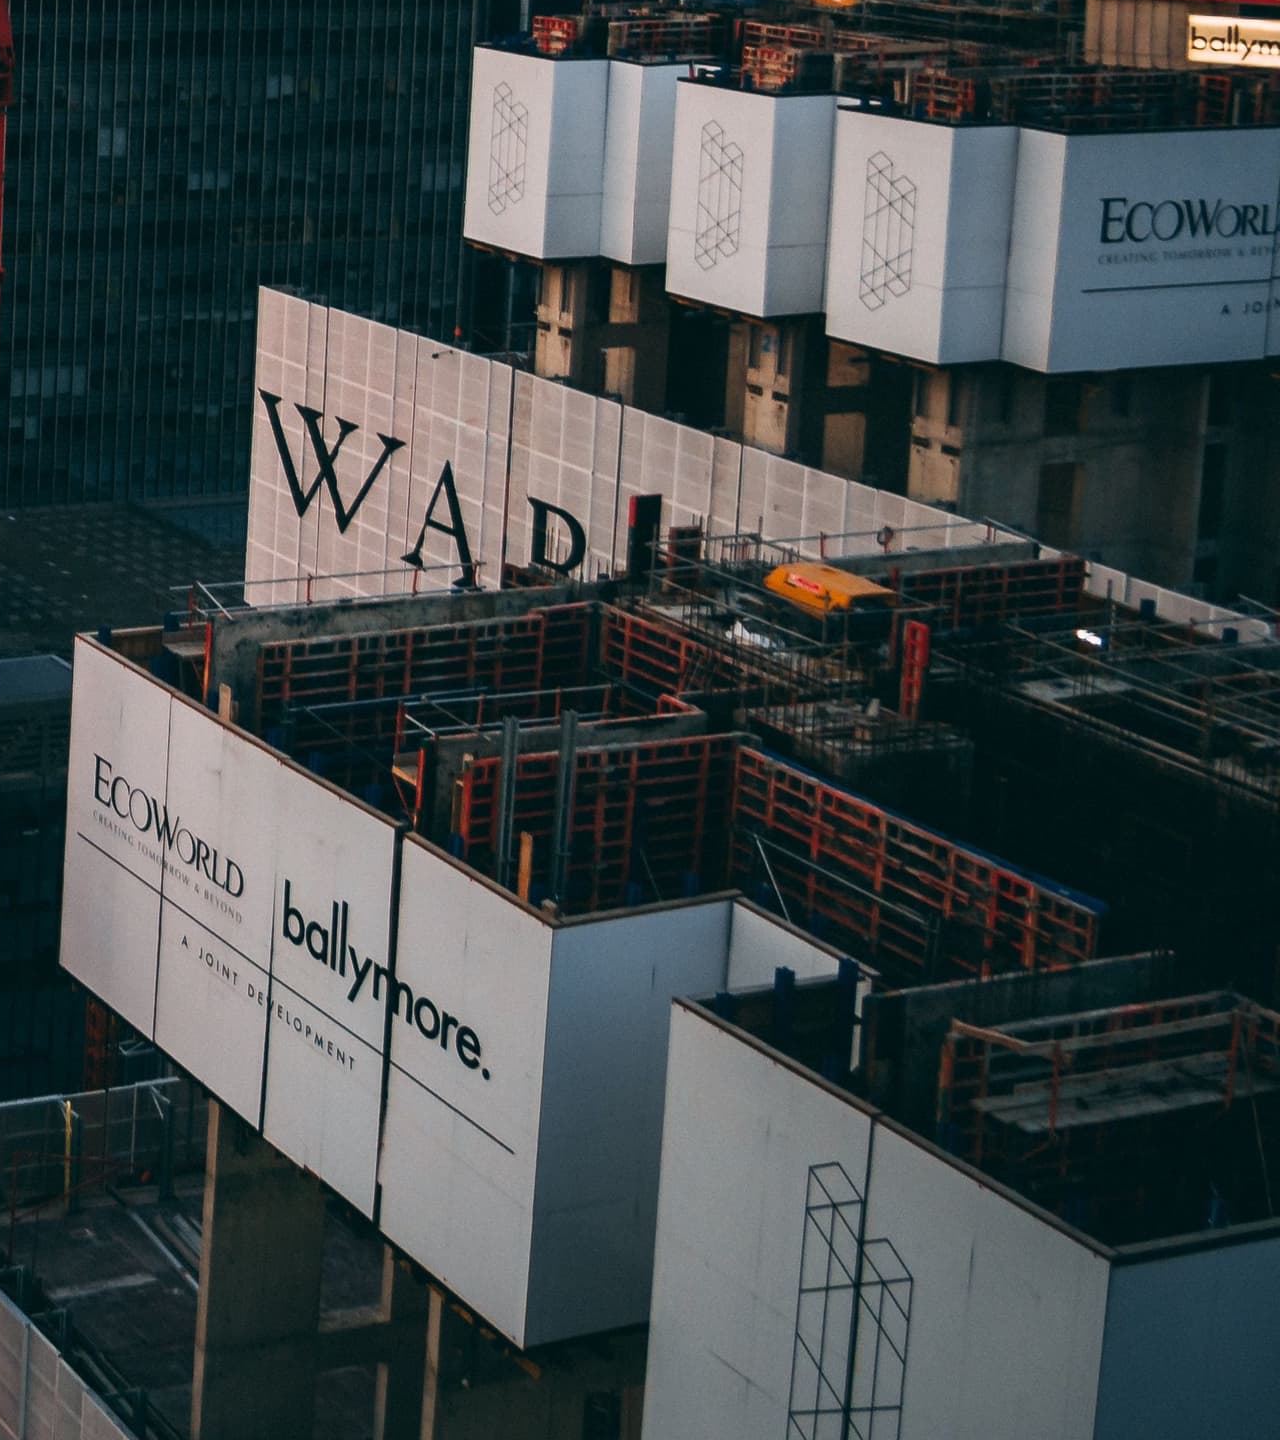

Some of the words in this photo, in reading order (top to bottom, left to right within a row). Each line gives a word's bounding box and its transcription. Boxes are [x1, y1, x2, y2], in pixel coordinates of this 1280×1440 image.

[181, 935, 189, 950] A
[198, 947, 238, 986] JOINT
[247, 982, 355, 1071] DEVELOPMENT
[283, 878, 490, 1081] ballymore.
